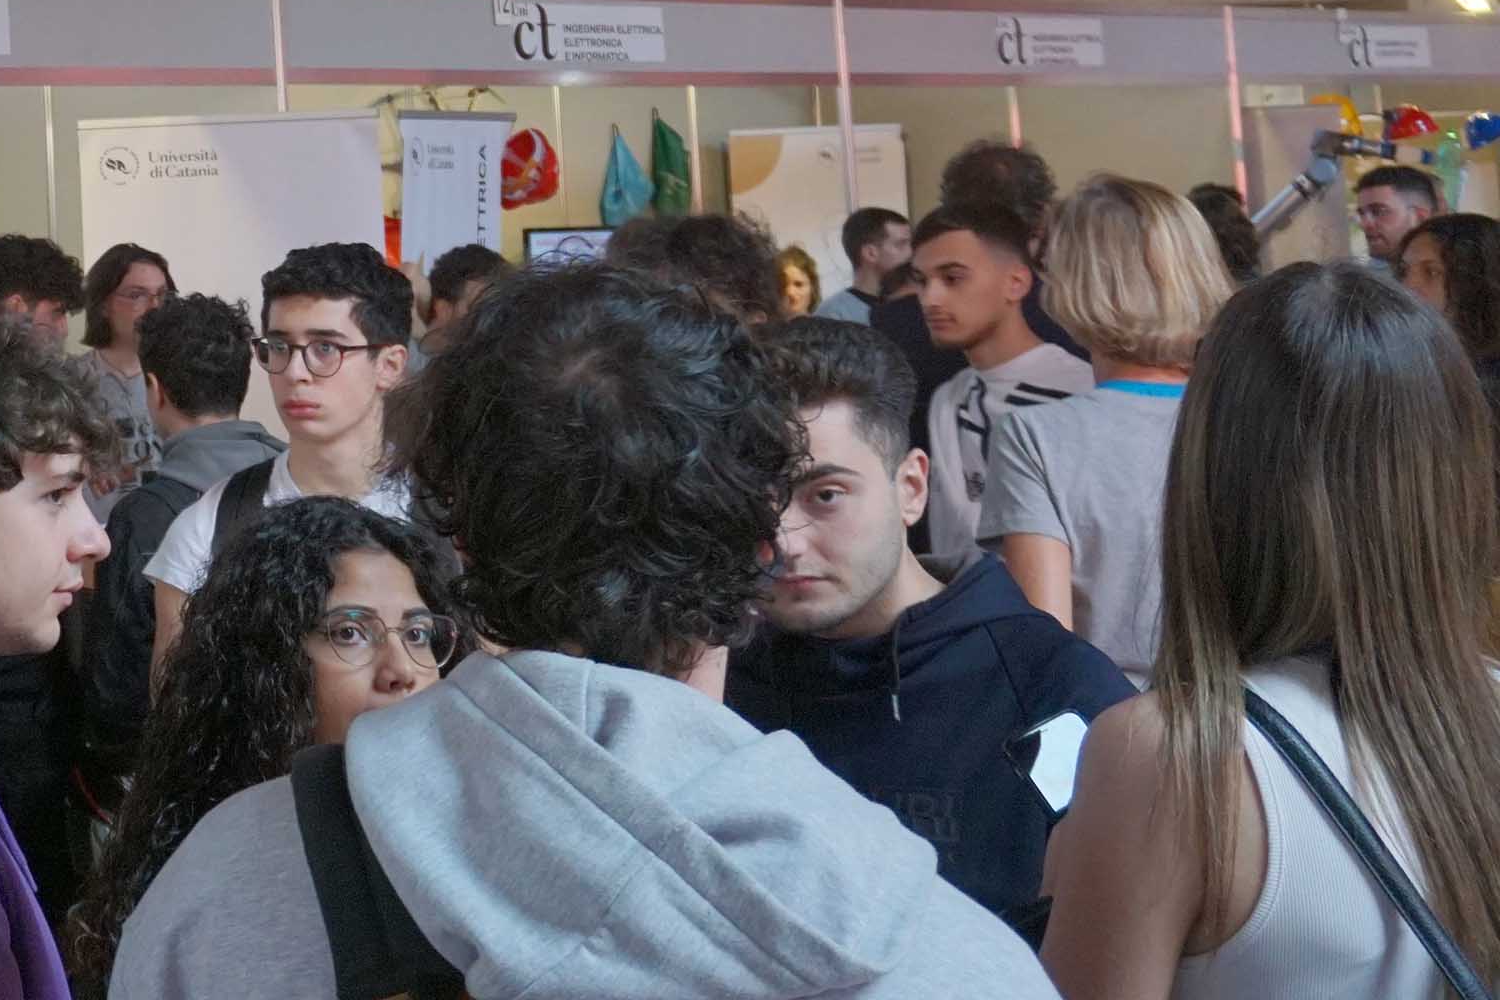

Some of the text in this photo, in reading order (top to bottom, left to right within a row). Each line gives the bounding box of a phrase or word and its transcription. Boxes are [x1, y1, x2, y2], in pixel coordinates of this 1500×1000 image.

[514, 3, 557, 60] ct
[563, 24, 615, 34] INGEGNERIA
[148, 149, 218, 163] Università
[150, 165, 219, 178] di Catania
